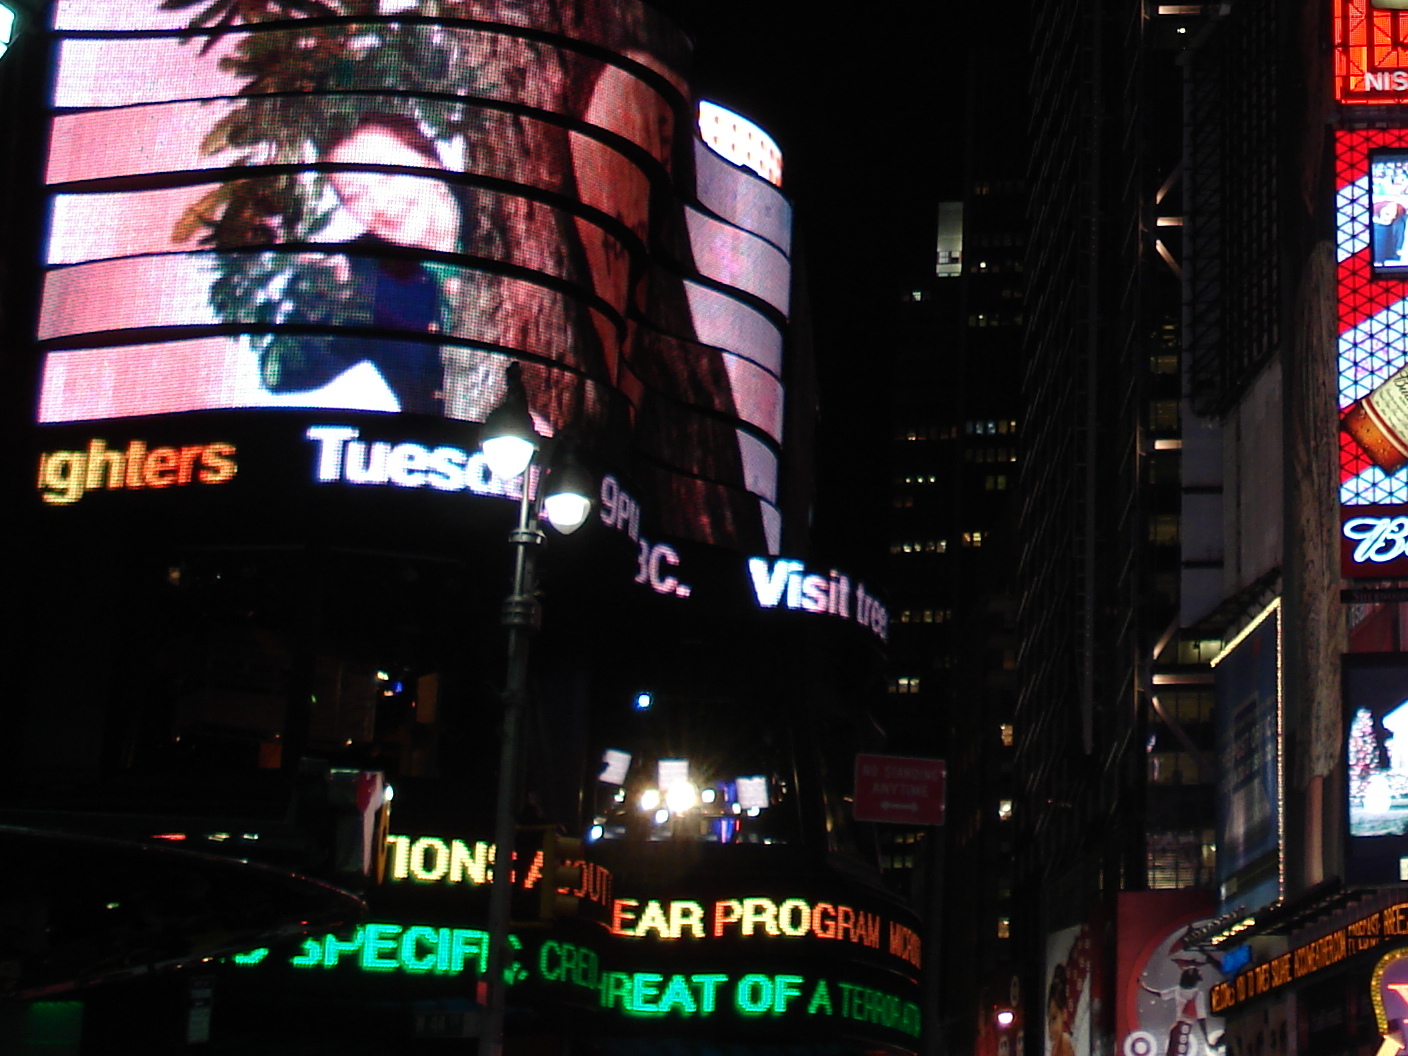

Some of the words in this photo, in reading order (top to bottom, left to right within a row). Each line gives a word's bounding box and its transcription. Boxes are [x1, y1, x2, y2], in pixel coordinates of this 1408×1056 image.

[38, 439, 238, 505] ghters
[748, 557, 850, 619] Visit
[713, 896, 882, 949] PROGRAM
[736, 971, 806, 1016] OF
[806, 978, 835, 1017] A
